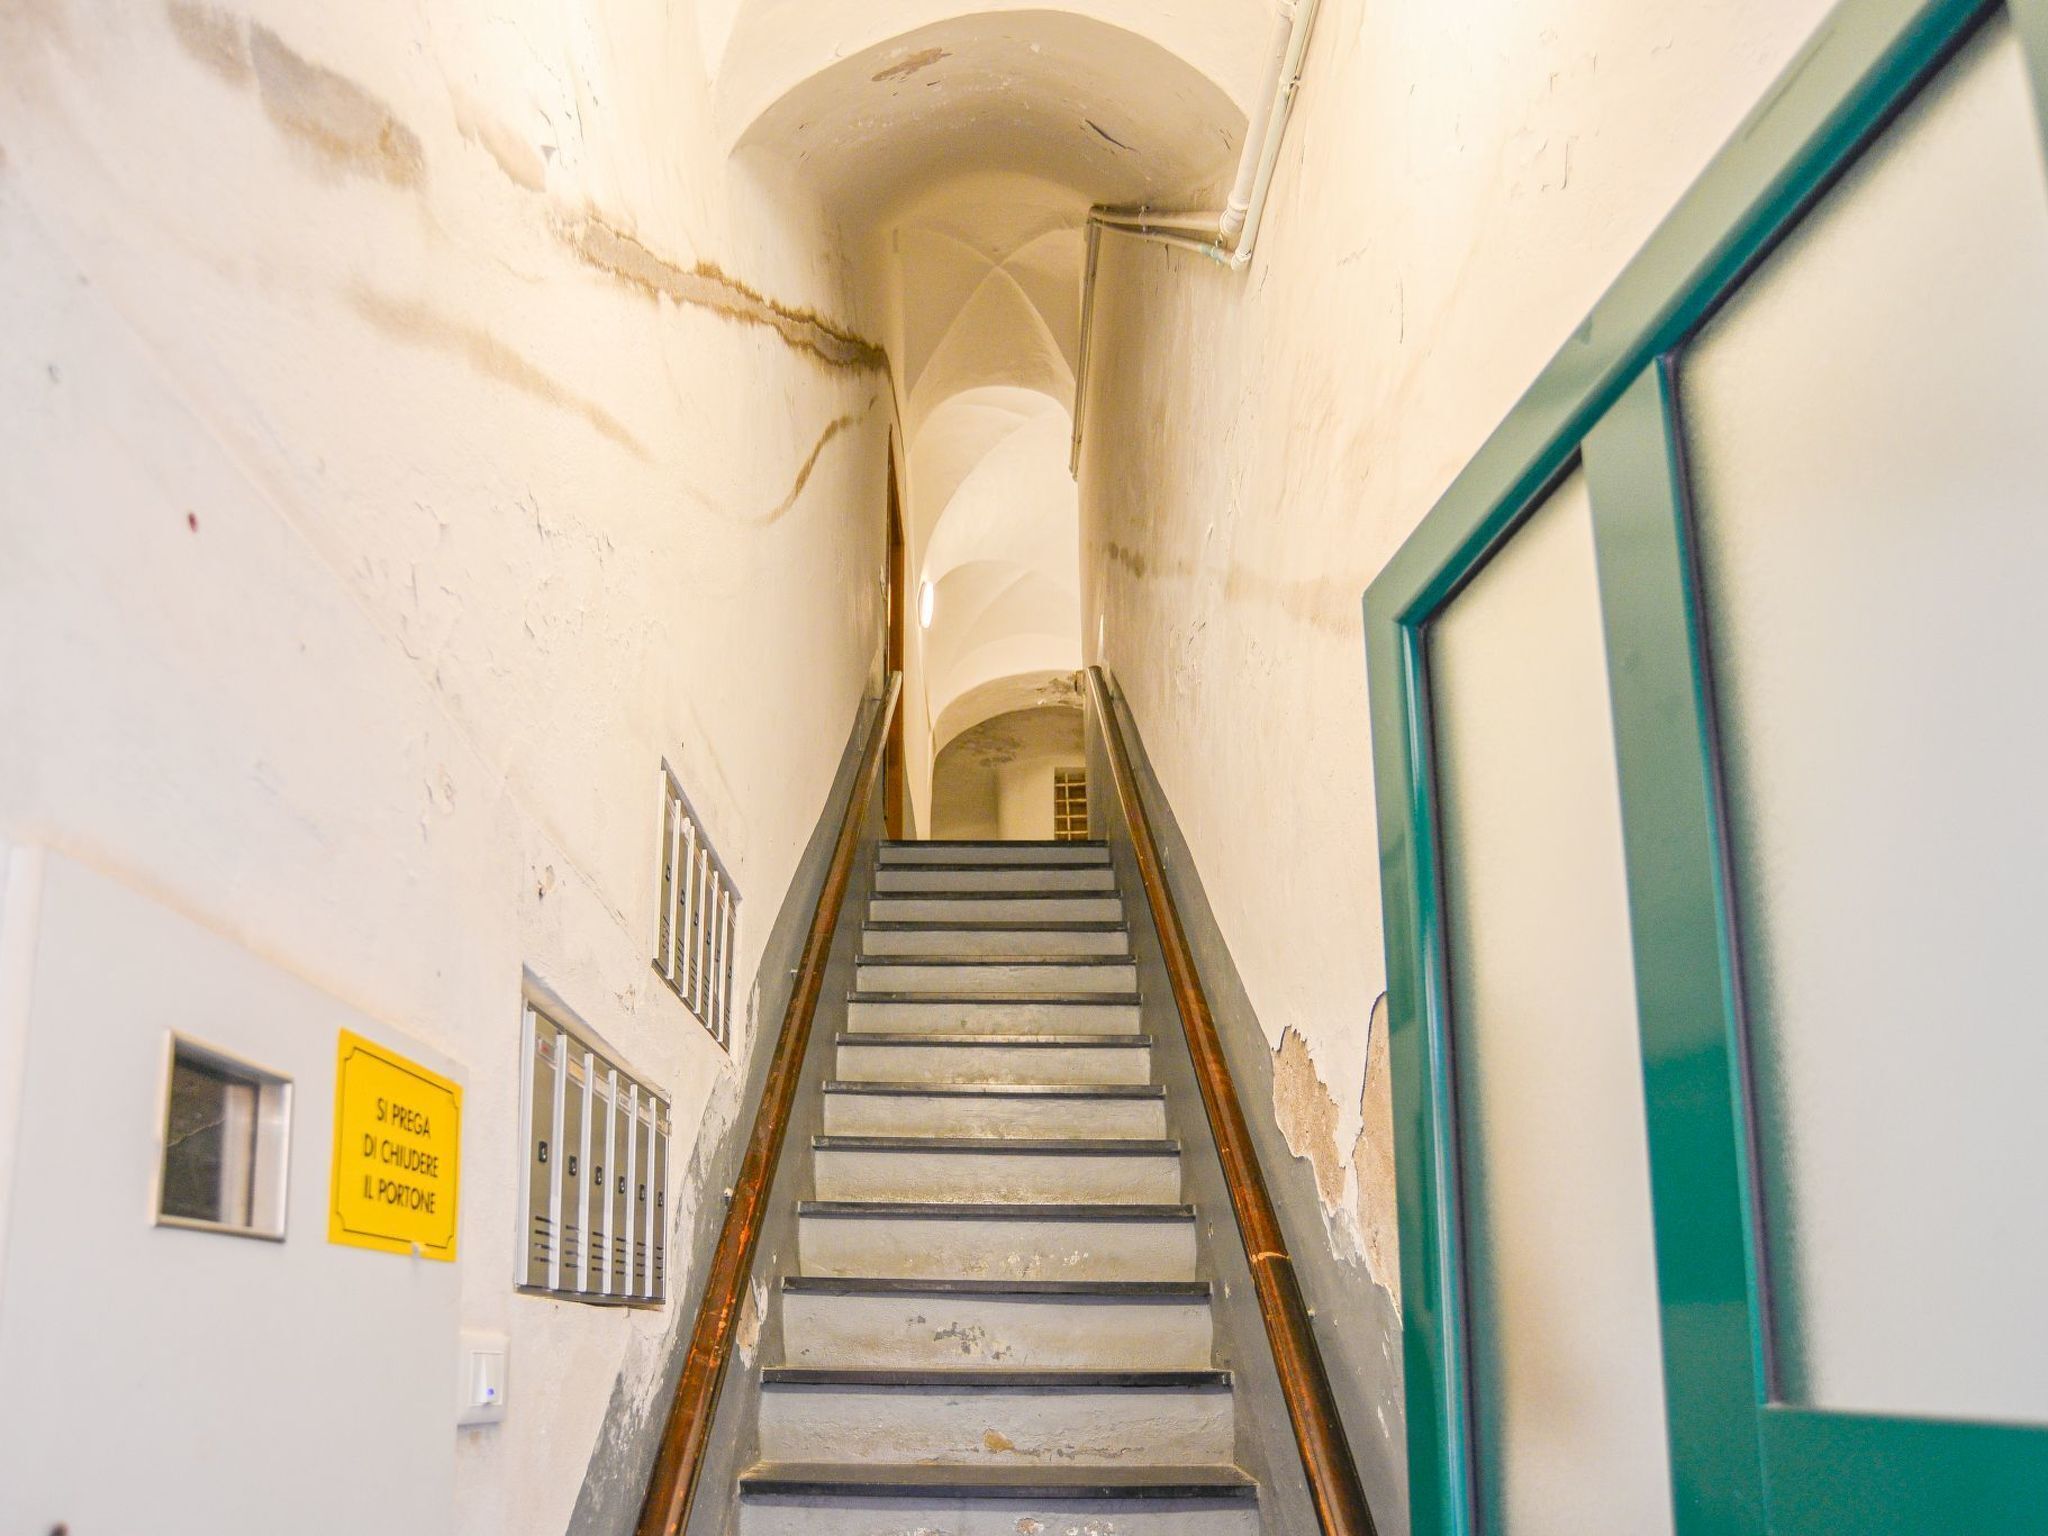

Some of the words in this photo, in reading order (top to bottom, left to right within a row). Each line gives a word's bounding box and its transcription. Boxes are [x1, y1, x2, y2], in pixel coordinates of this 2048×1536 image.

[377, 1098, 388, 1122] SI
[392, 1103, 431, 1138] PREGA
[364, 1133, 378, 1159] DI
[381, 1139, 439, 1178] CHIUDERE
[364, 1175, 374, 1199] IL
[379, 1178, 435, 1214] PORTONE
